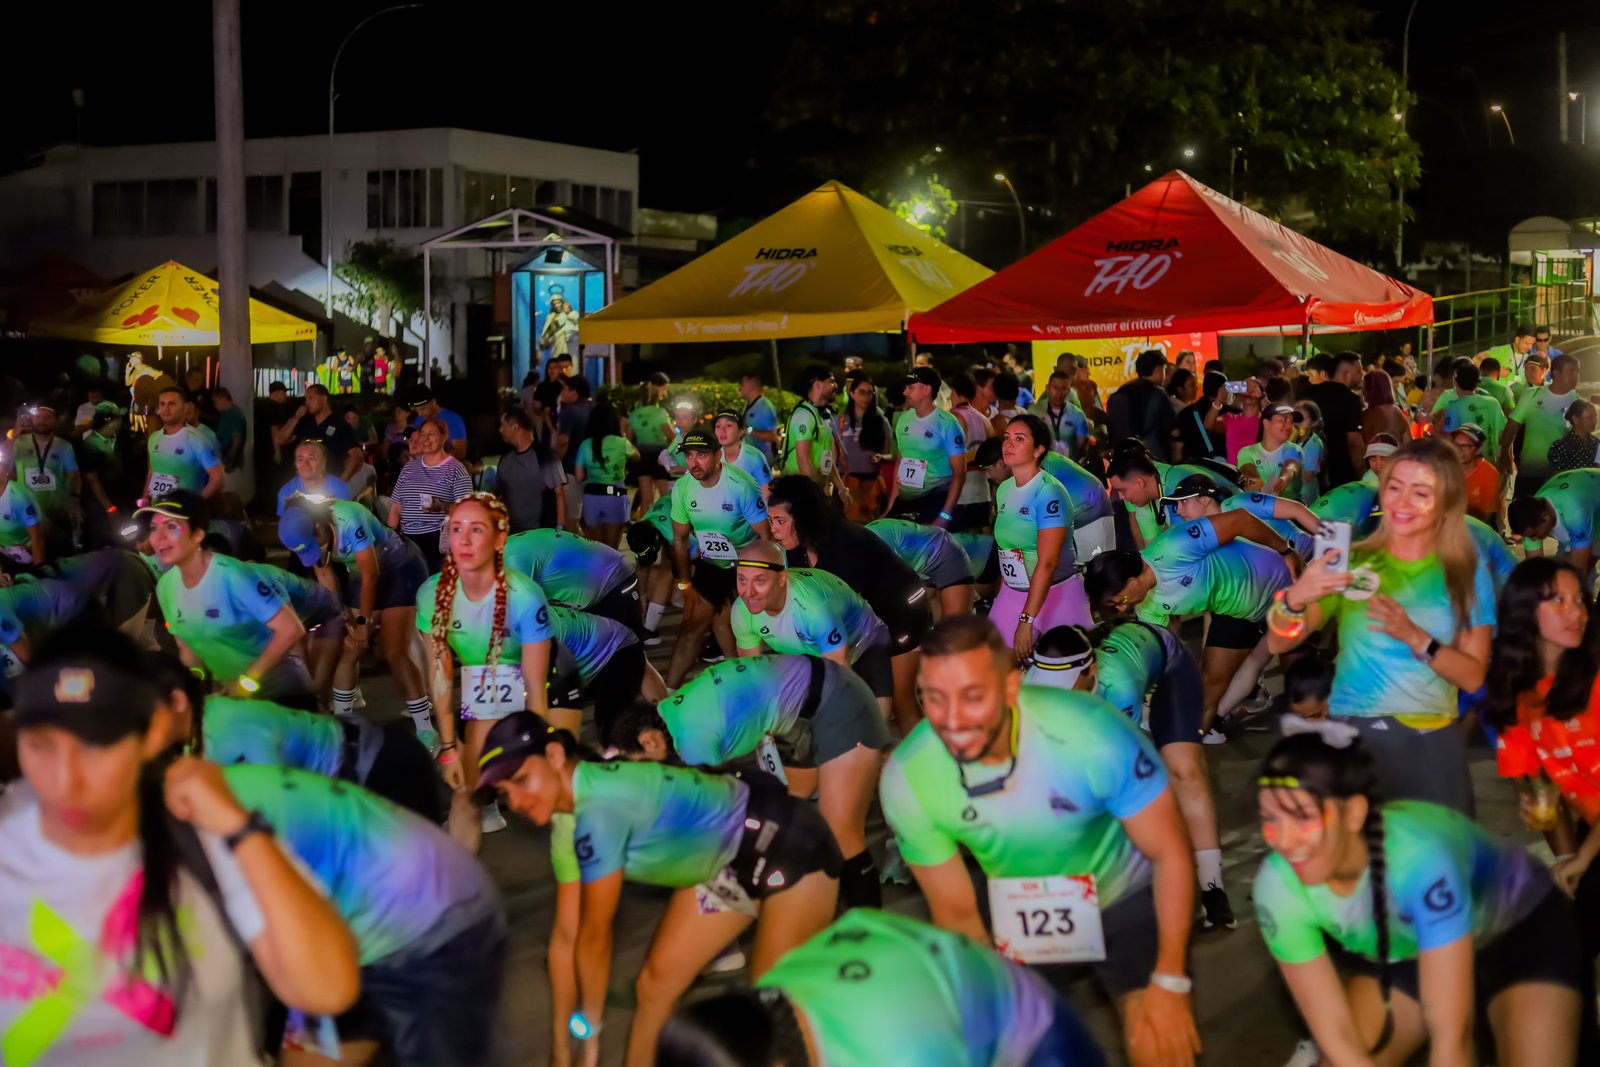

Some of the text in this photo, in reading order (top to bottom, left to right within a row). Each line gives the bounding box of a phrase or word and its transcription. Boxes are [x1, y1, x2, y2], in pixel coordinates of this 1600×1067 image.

[1105, 237, 1180, 253] HIDRA
[755, 247, 818, 260] HIDRA
[110, 275, 160, 315] POKER
[1065, 321, 1117, 333] mantener
[1131, 318, 1162, 330] ritmo
[1086, 355, 1123, 367] IDRA
[906, 468, 916, 478] 17
[153, 481, 173, 492] 207
[705, 540, 730, 552] 236
[1002, 563, 1017, 577] 62
[473, 684, 513, 704] 272
[1016, 908, 1075, 938] 123
